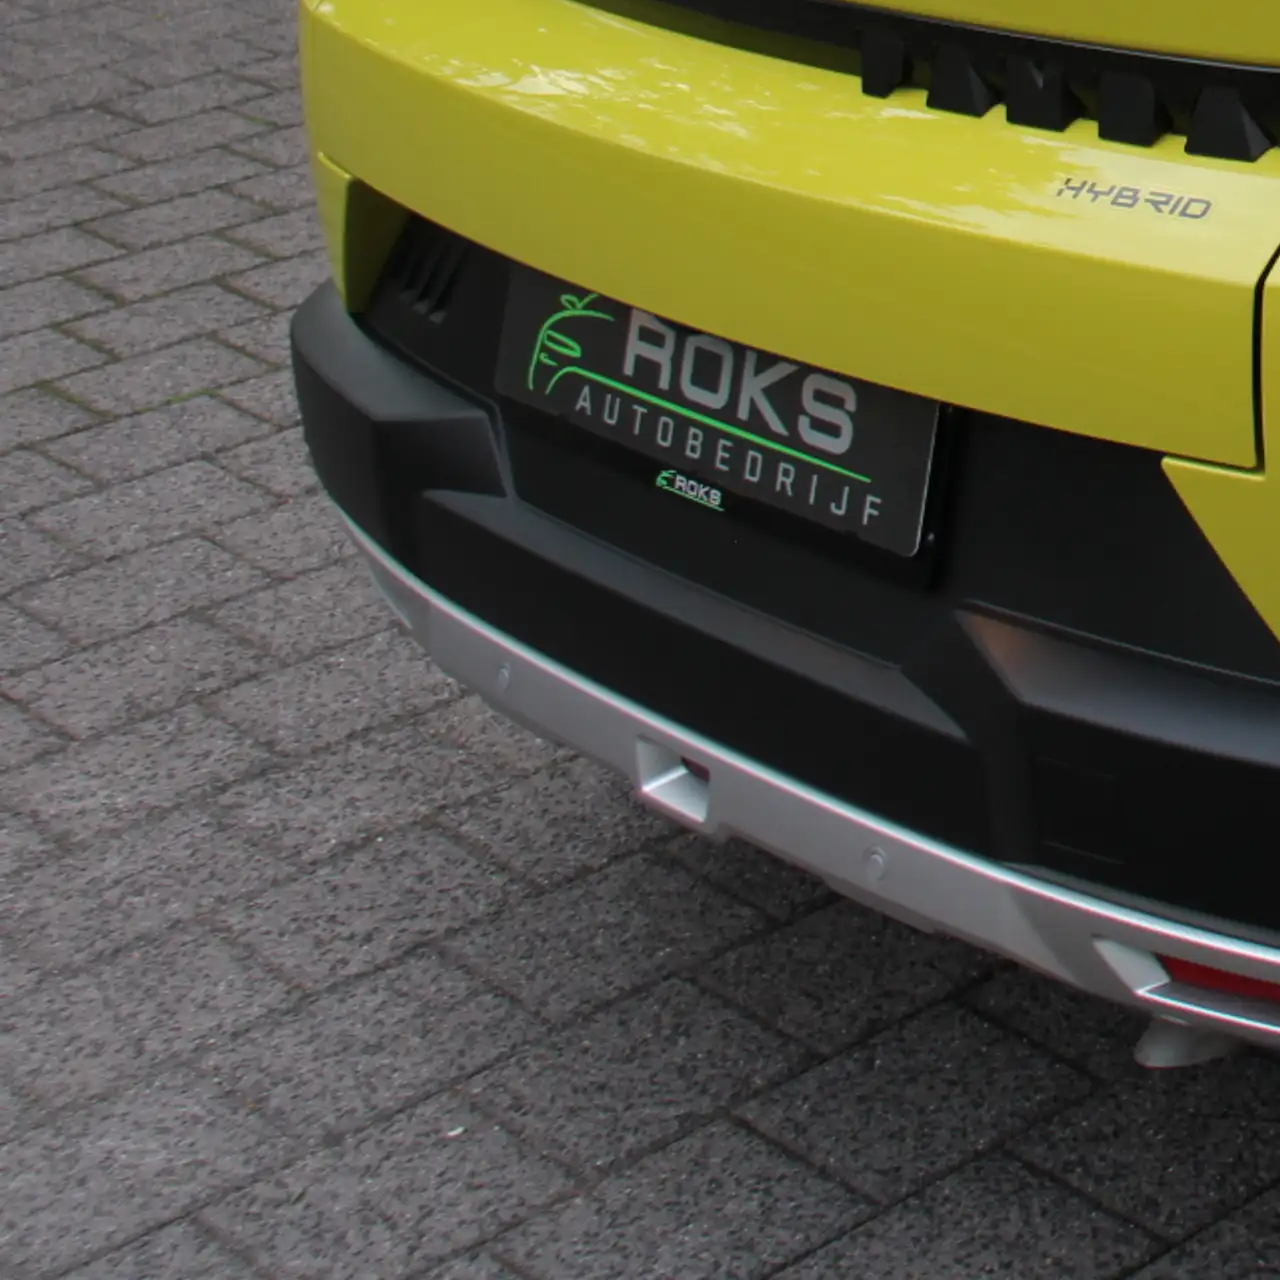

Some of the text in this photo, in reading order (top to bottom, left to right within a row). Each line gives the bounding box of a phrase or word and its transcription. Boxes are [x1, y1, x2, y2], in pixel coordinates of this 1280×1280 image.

[1056, 177, 1212, 219] HYBRID
[623, 307, 856, 455] ROKS
[575, 384, 882, 526] AUTOBEDRIJF
